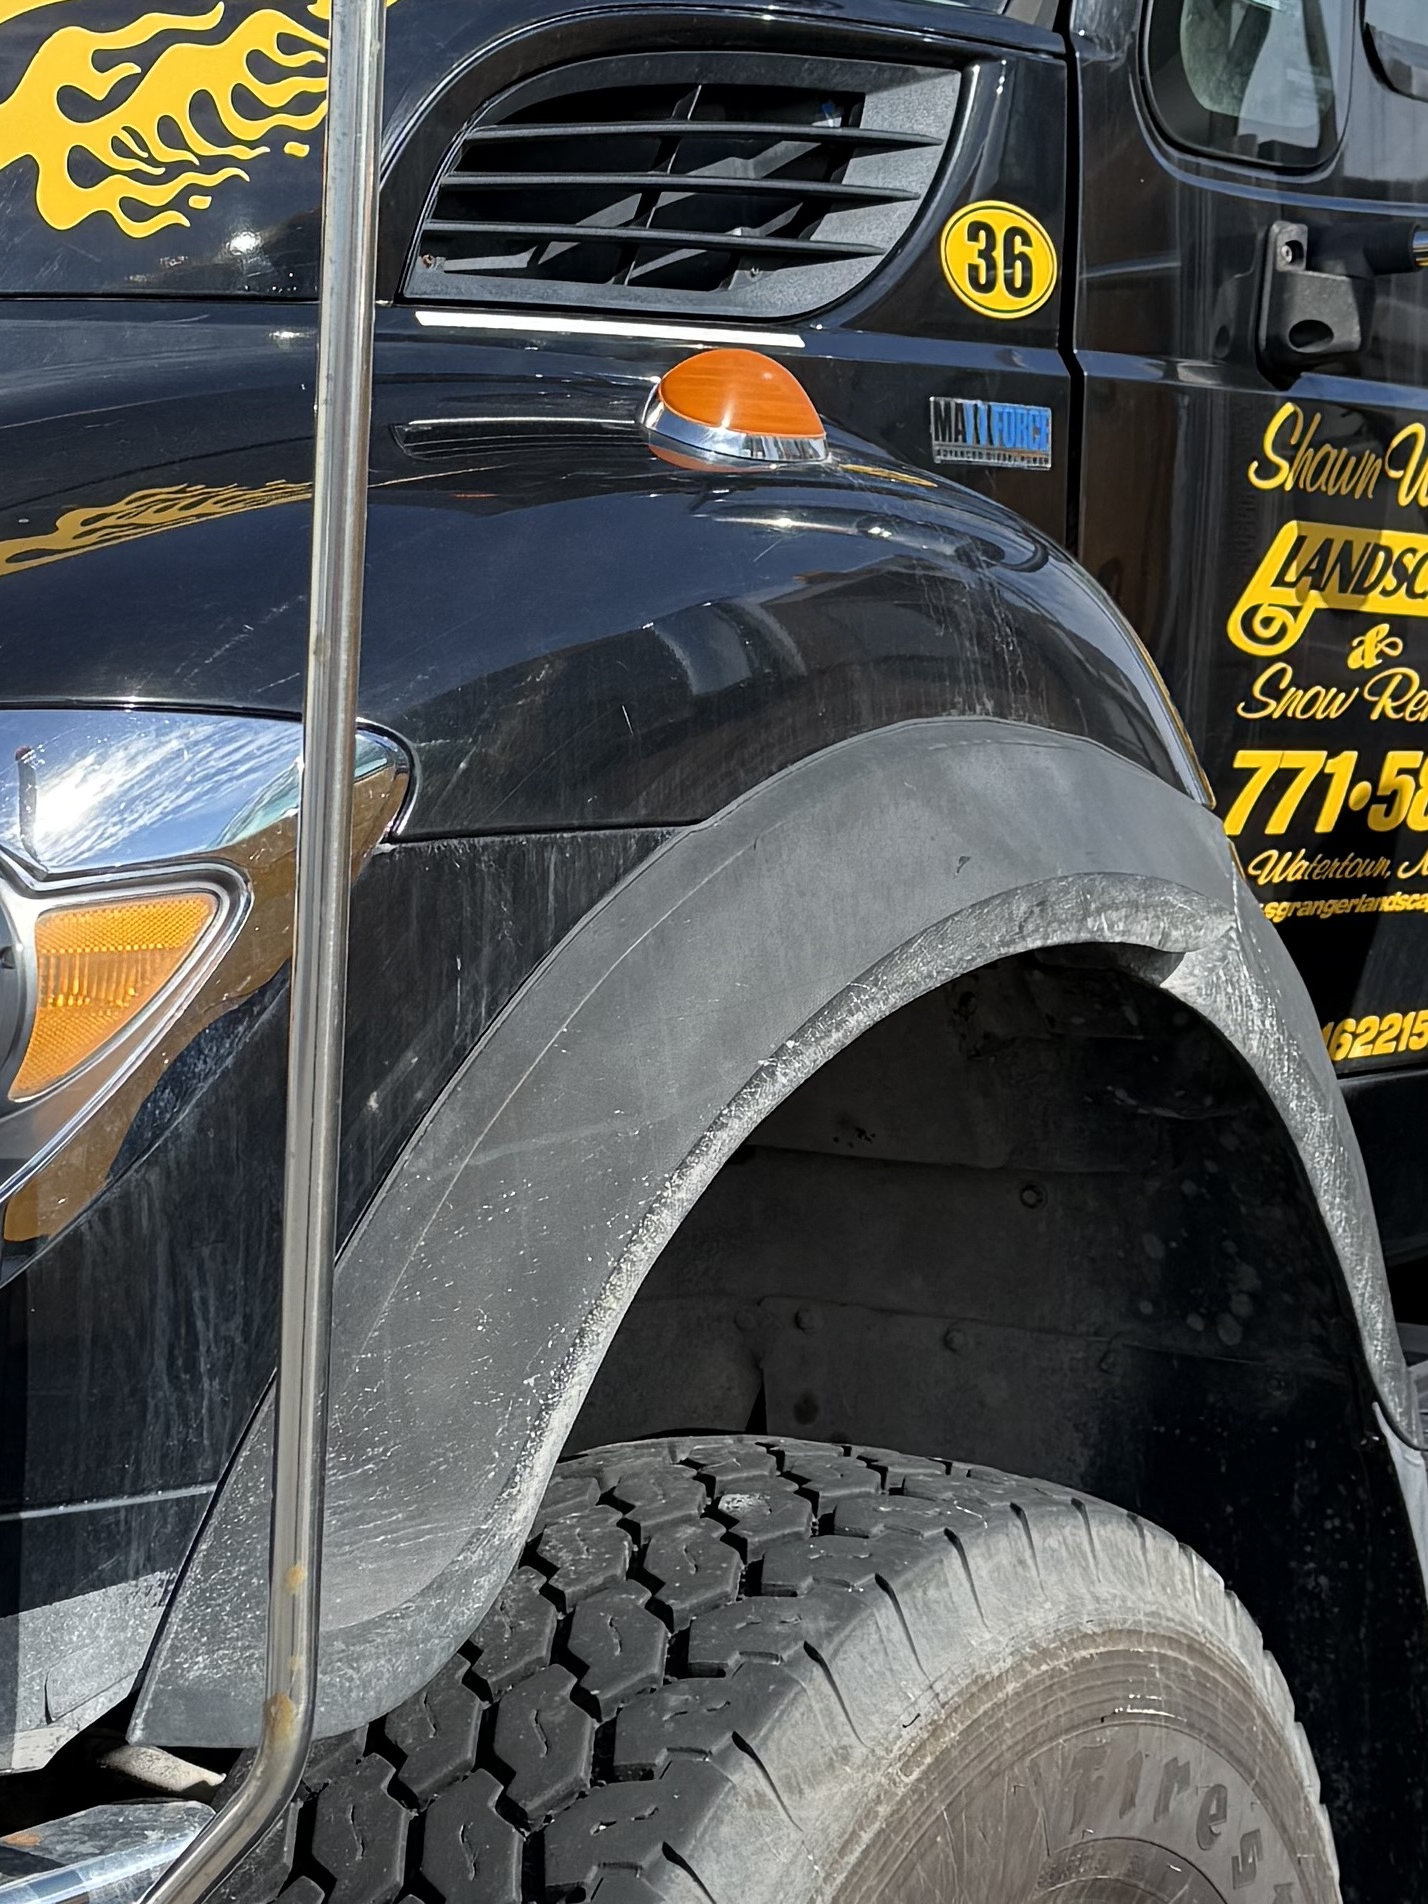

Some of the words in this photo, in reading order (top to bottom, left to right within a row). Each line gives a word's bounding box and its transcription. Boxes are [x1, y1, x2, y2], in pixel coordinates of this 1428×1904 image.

[966, 222, 1034, 299] 36
[1248, 401, 1383, 500] Shawn
[1347, 623, 1403, 670] &
[1236, 662, 1359, 721] Snow
[1247, 848, 1391, 887] Watertown,
